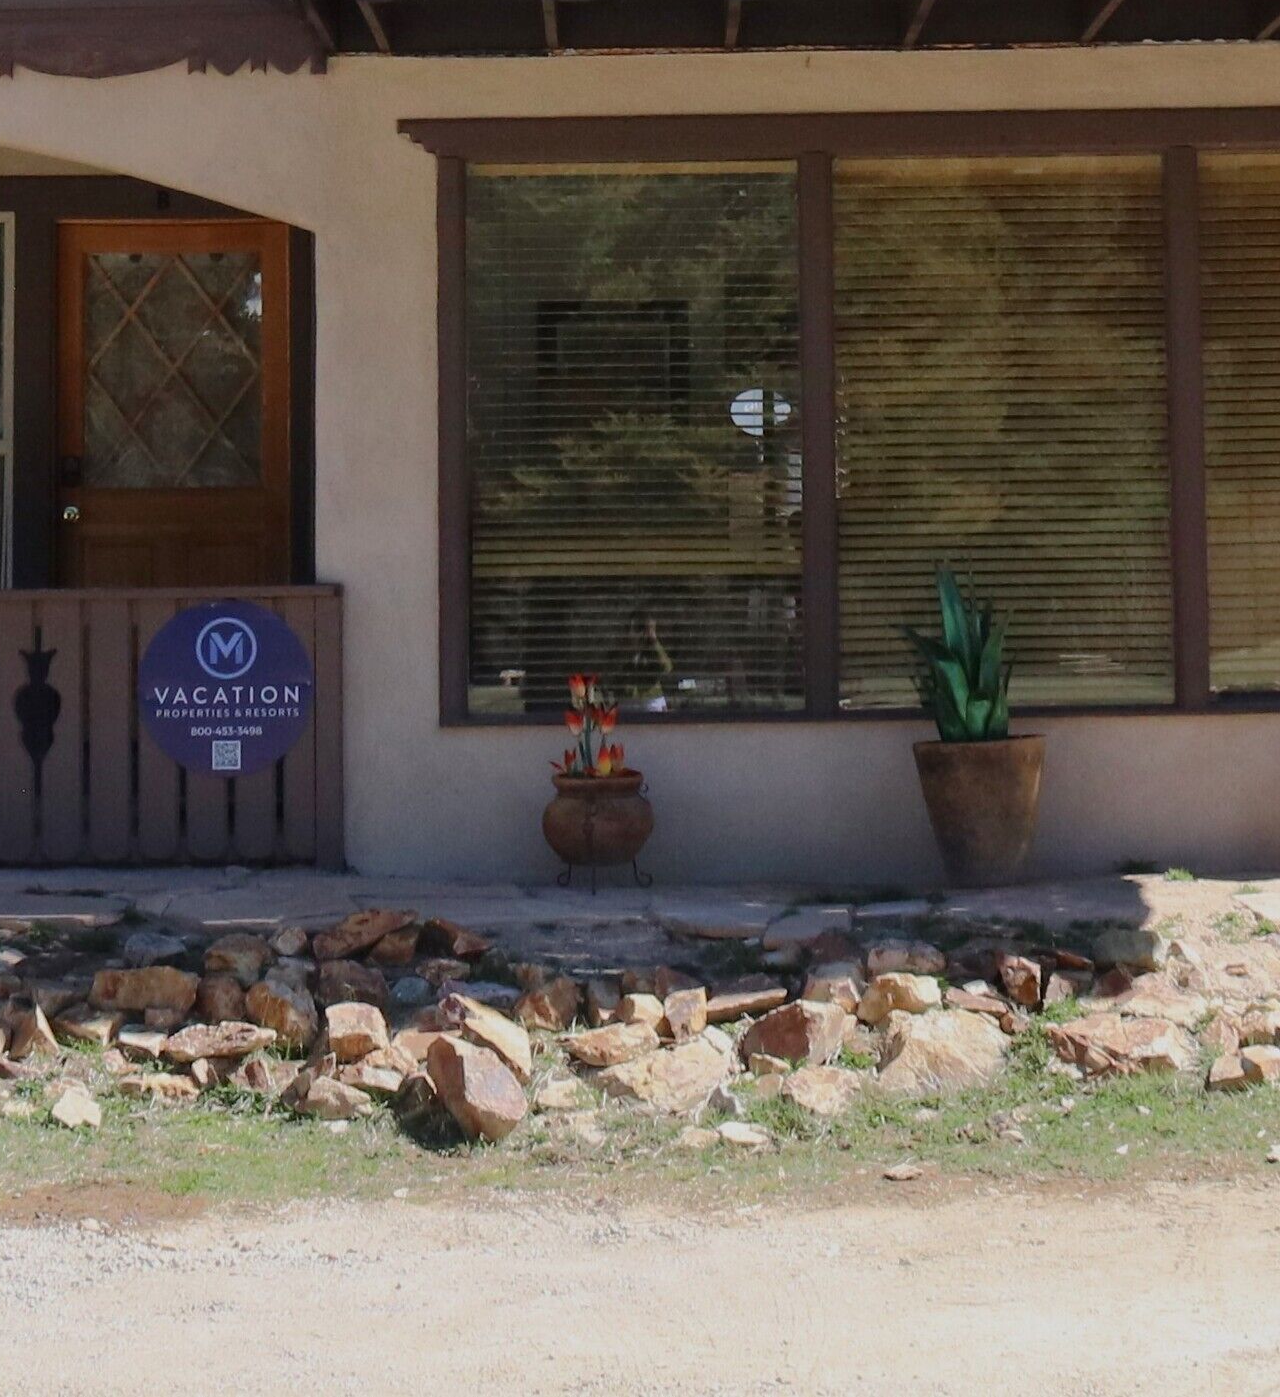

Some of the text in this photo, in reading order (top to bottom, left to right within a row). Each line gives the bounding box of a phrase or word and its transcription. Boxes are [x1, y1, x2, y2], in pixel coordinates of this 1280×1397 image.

[209, 632, 244, 665] M
[154, 686, 300, 704] VACATION
[155, 707, 300, 718] PROPERTIES & RESORTS
[190, 726, 263, 736] 800-453-3498
